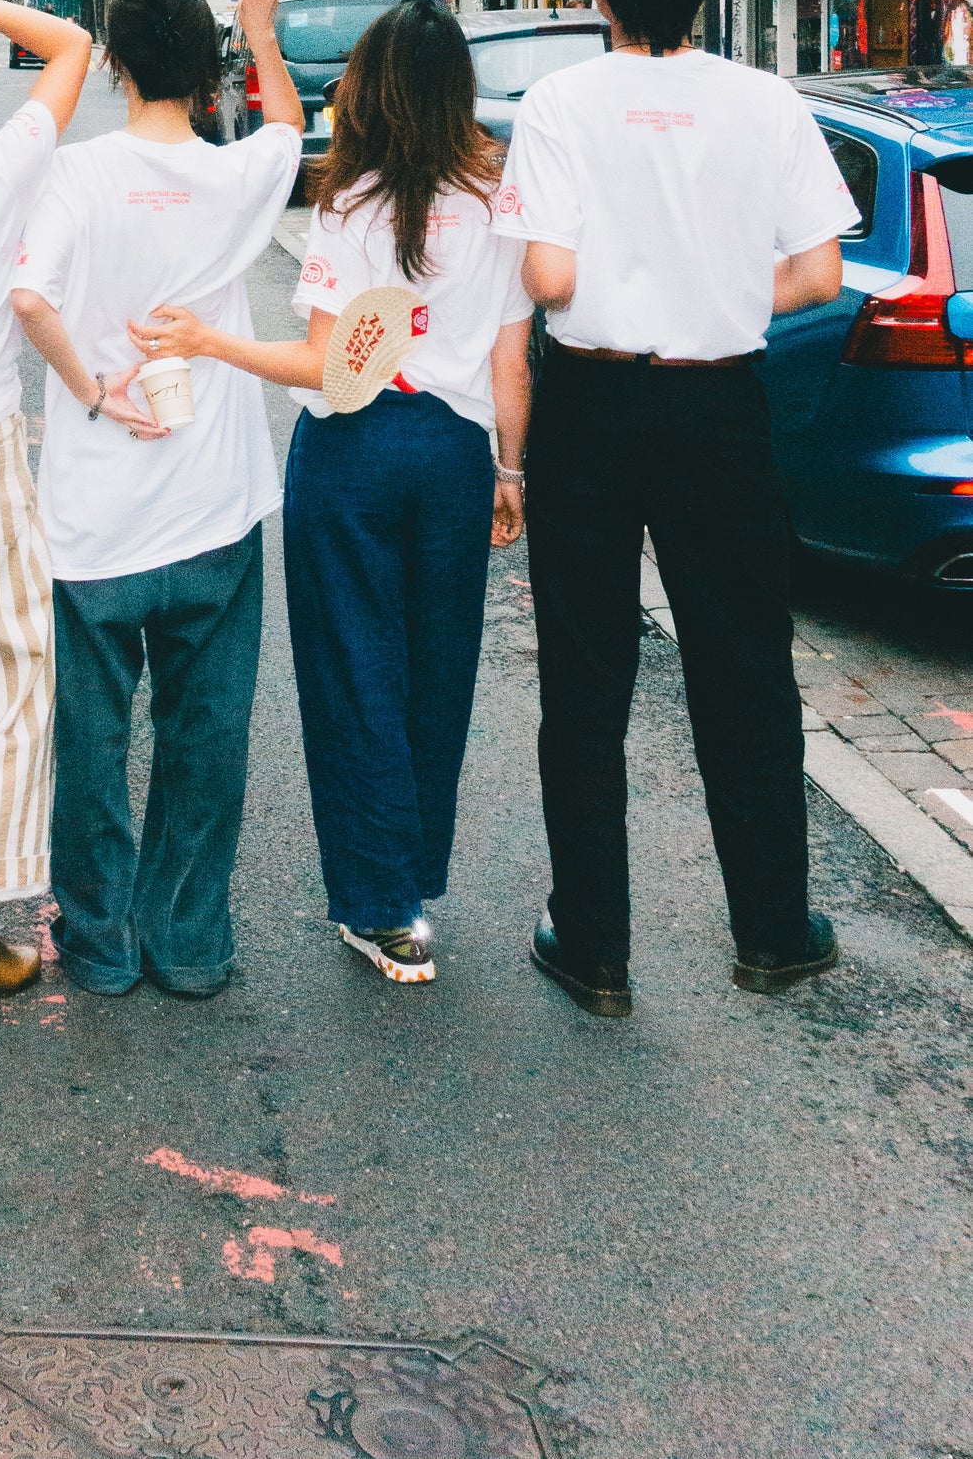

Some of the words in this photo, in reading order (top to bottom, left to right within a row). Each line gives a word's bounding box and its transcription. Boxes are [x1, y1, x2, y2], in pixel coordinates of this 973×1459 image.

[345, 314, 367, 354] HOT
[347, 312, 381, 371] ASIAN
[354, 326, 386, 375] BUNS
